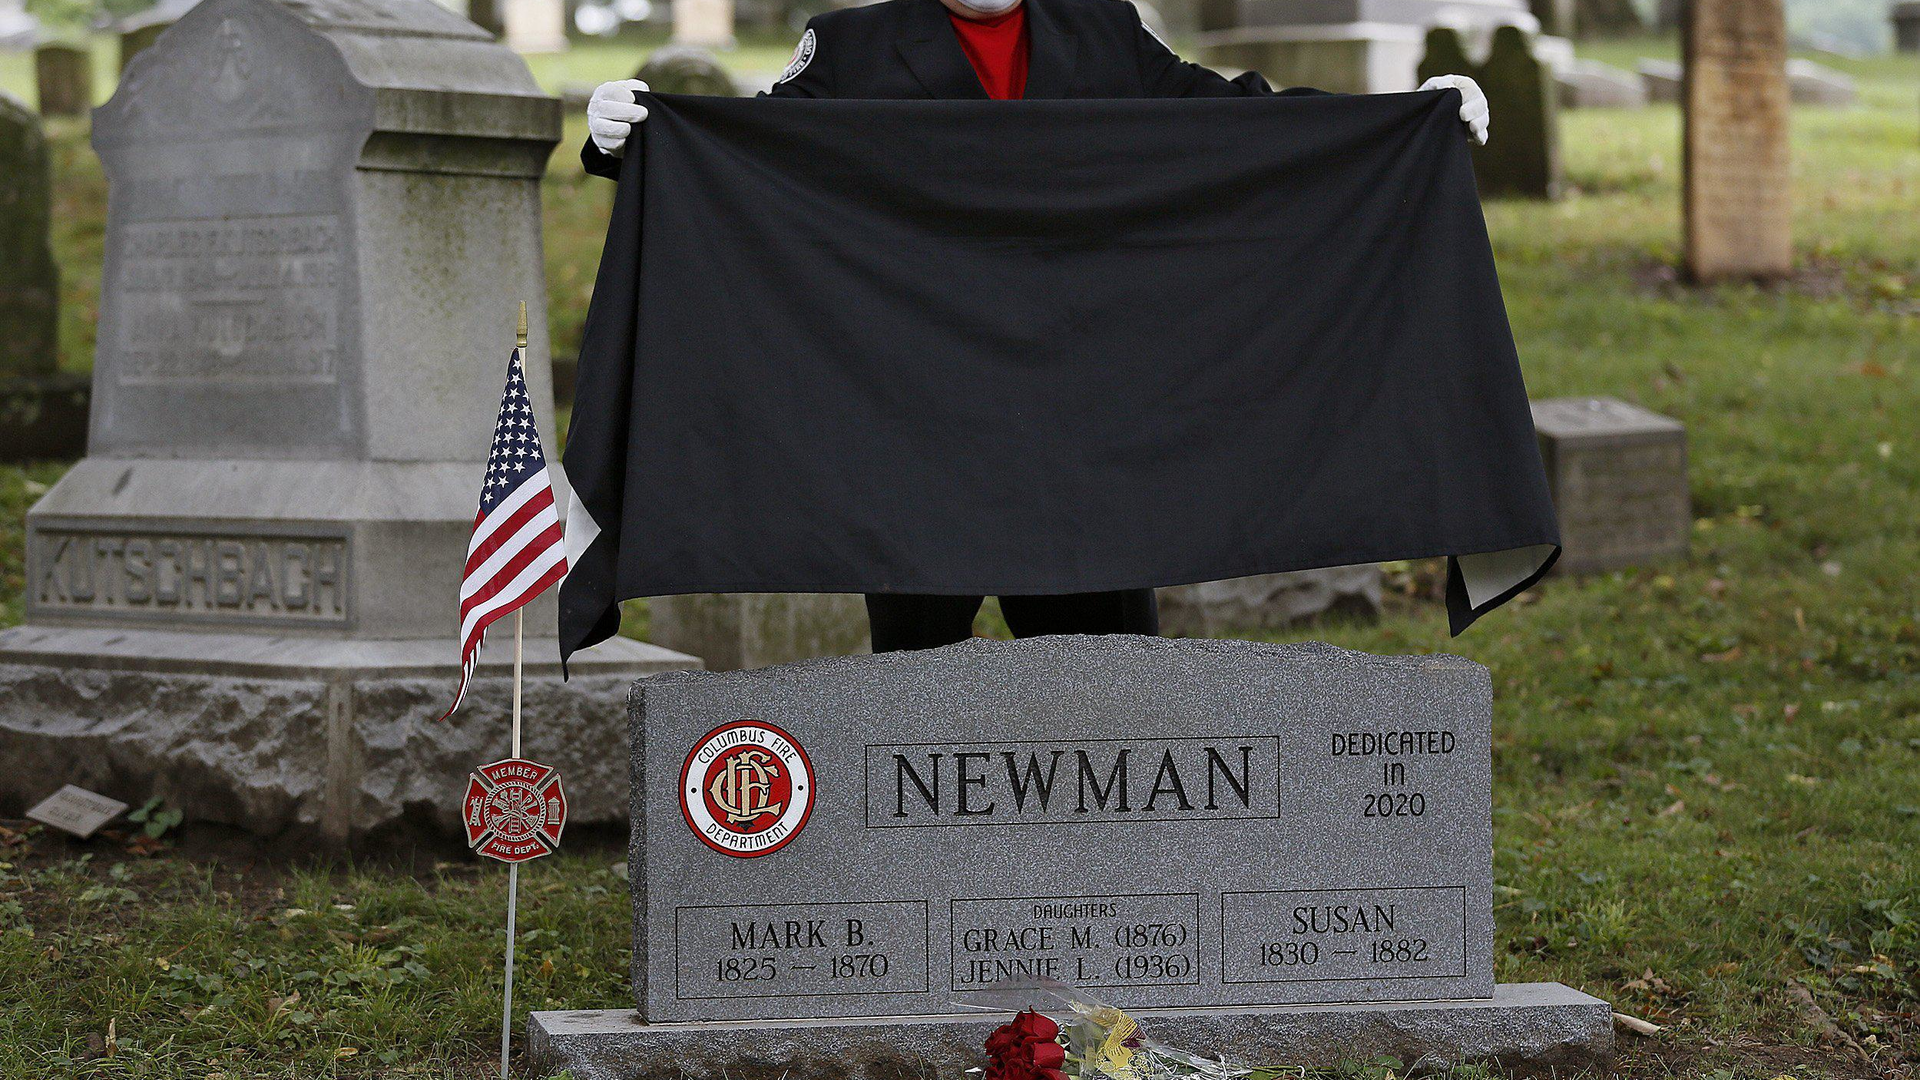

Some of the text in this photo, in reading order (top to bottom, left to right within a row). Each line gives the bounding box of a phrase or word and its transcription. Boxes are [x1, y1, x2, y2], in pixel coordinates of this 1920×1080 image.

[37, 535, 343, 616] KUTSCHBACH
[698, 729, 797, 764] COLUMBUS FIRE
[1331, 731, 1456, 756] DEDICATED
[491, 766, 538, 780] MEMBER
[892, 746, 1253, 818] NEWMAN
[1363, 793, 1426, 817] 2020
[491, 842, 511, 854] FIRE
[705, 821, 789, 849] DEPARTMENT
[1033, 902, 1117, 919] DAUGHTERS
[1292, 904, 1396, 935] SUSAN
[730, 918, 874, 951] MARK B.
[963, 923, 1187, 952] GRACE M. (1876)
[1260, 941, 1319, 966] 1830
[1371, 939, 1428, 964] 1882
[717, 957, 777, 982] 1825
[831, 953, 889, 979] 1870
[961, 954, 1191, 984] JENNIE L. (1936)
